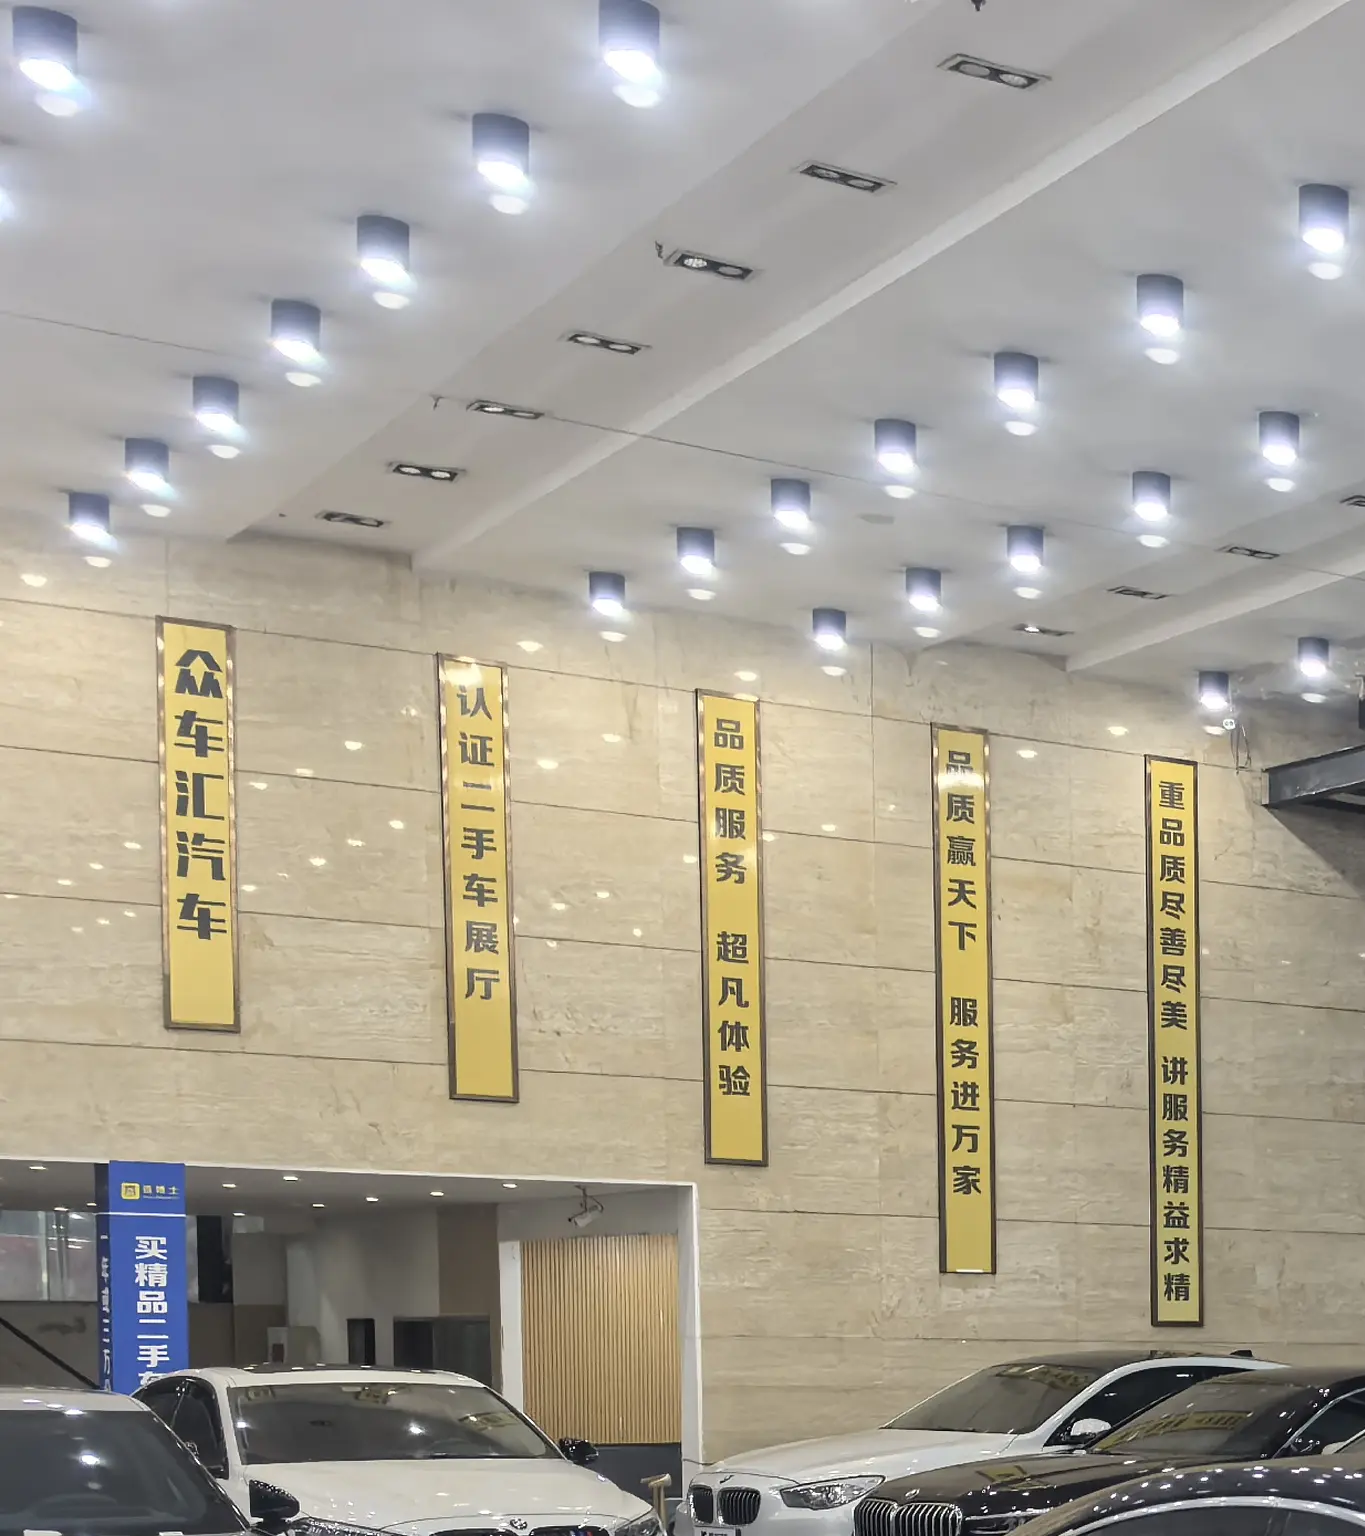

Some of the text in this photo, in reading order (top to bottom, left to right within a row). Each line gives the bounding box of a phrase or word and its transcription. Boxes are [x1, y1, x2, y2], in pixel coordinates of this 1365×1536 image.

[174, 649, 227, 940] 众车汇汽车
[456, 685, 500, 1001] 认证二手车展厅
[712, 718, 751, 1098] 品质服务 超凡体验
[944, 750, 982, 1197] 品质赢天下 服务进万家
[1157, 780, 1191, 1302] 重品质尽善尽美 讲服务精益求精
